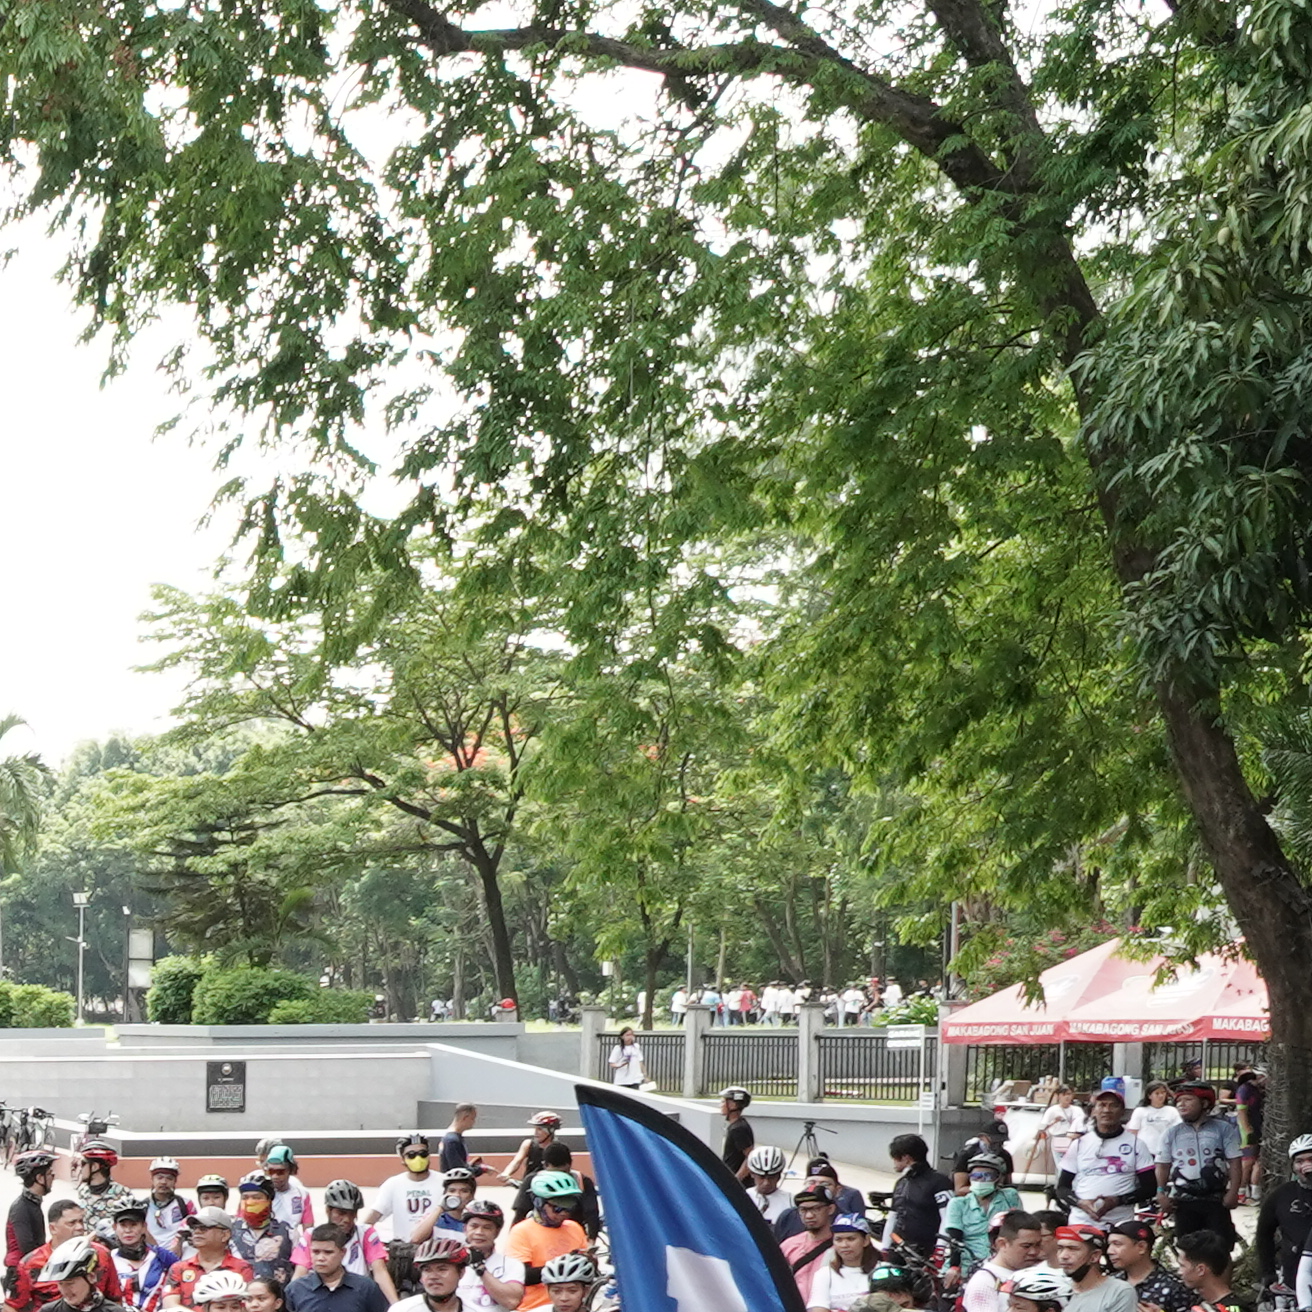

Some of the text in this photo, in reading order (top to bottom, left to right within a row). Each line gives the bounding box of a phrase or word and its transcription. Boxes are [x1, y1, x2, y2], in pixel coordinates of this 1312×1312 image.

[947, 1024, 1054, 1036] MAKABAGONG SAN JUAN
[1141, 1023, 1163, 1035] SAN
[1212, 1018, 1270, 1032] MAKABAG
[406, 1198, 432, 1214] UP
